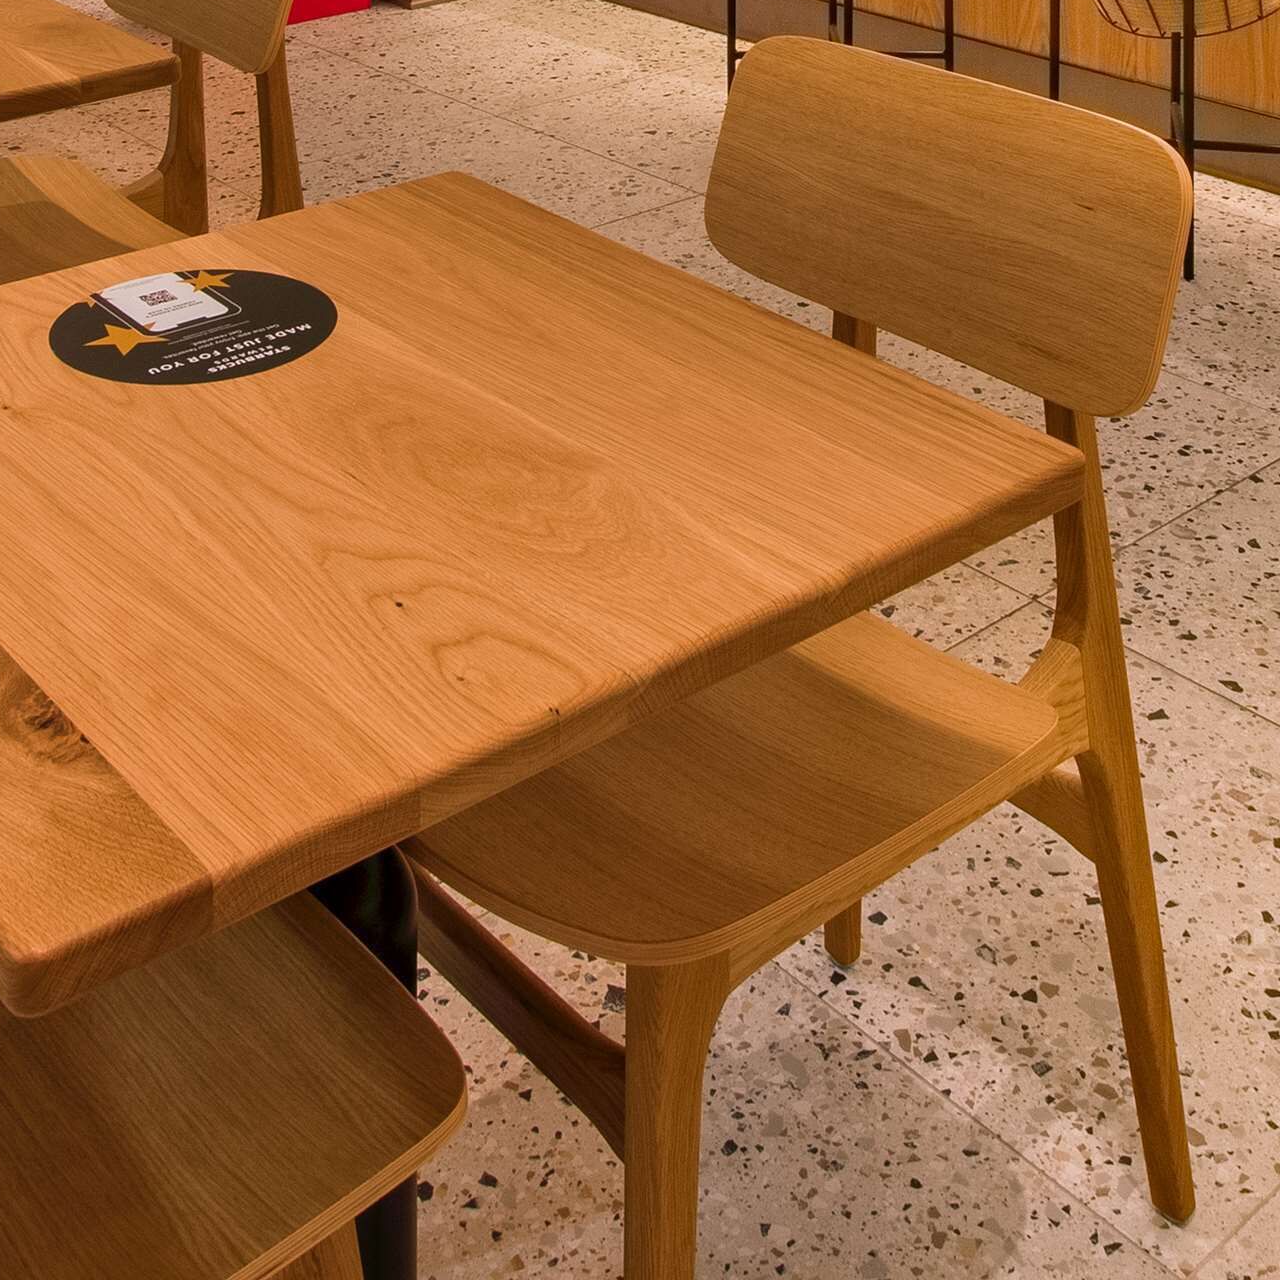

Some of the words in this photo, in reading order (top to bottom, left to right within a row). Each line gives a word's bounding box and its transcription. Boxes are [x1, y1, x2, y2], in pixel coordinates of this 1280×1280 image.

[265, 322, 313, 341] MADE
[225, 337, 262, 353] JUST
[186, 349, 221, 364] FOR
[207, 345, 291, 374] STARBUCKS
[213, 345, 274, 365] REWARDS
[147, 361, 185, 375] YOU
